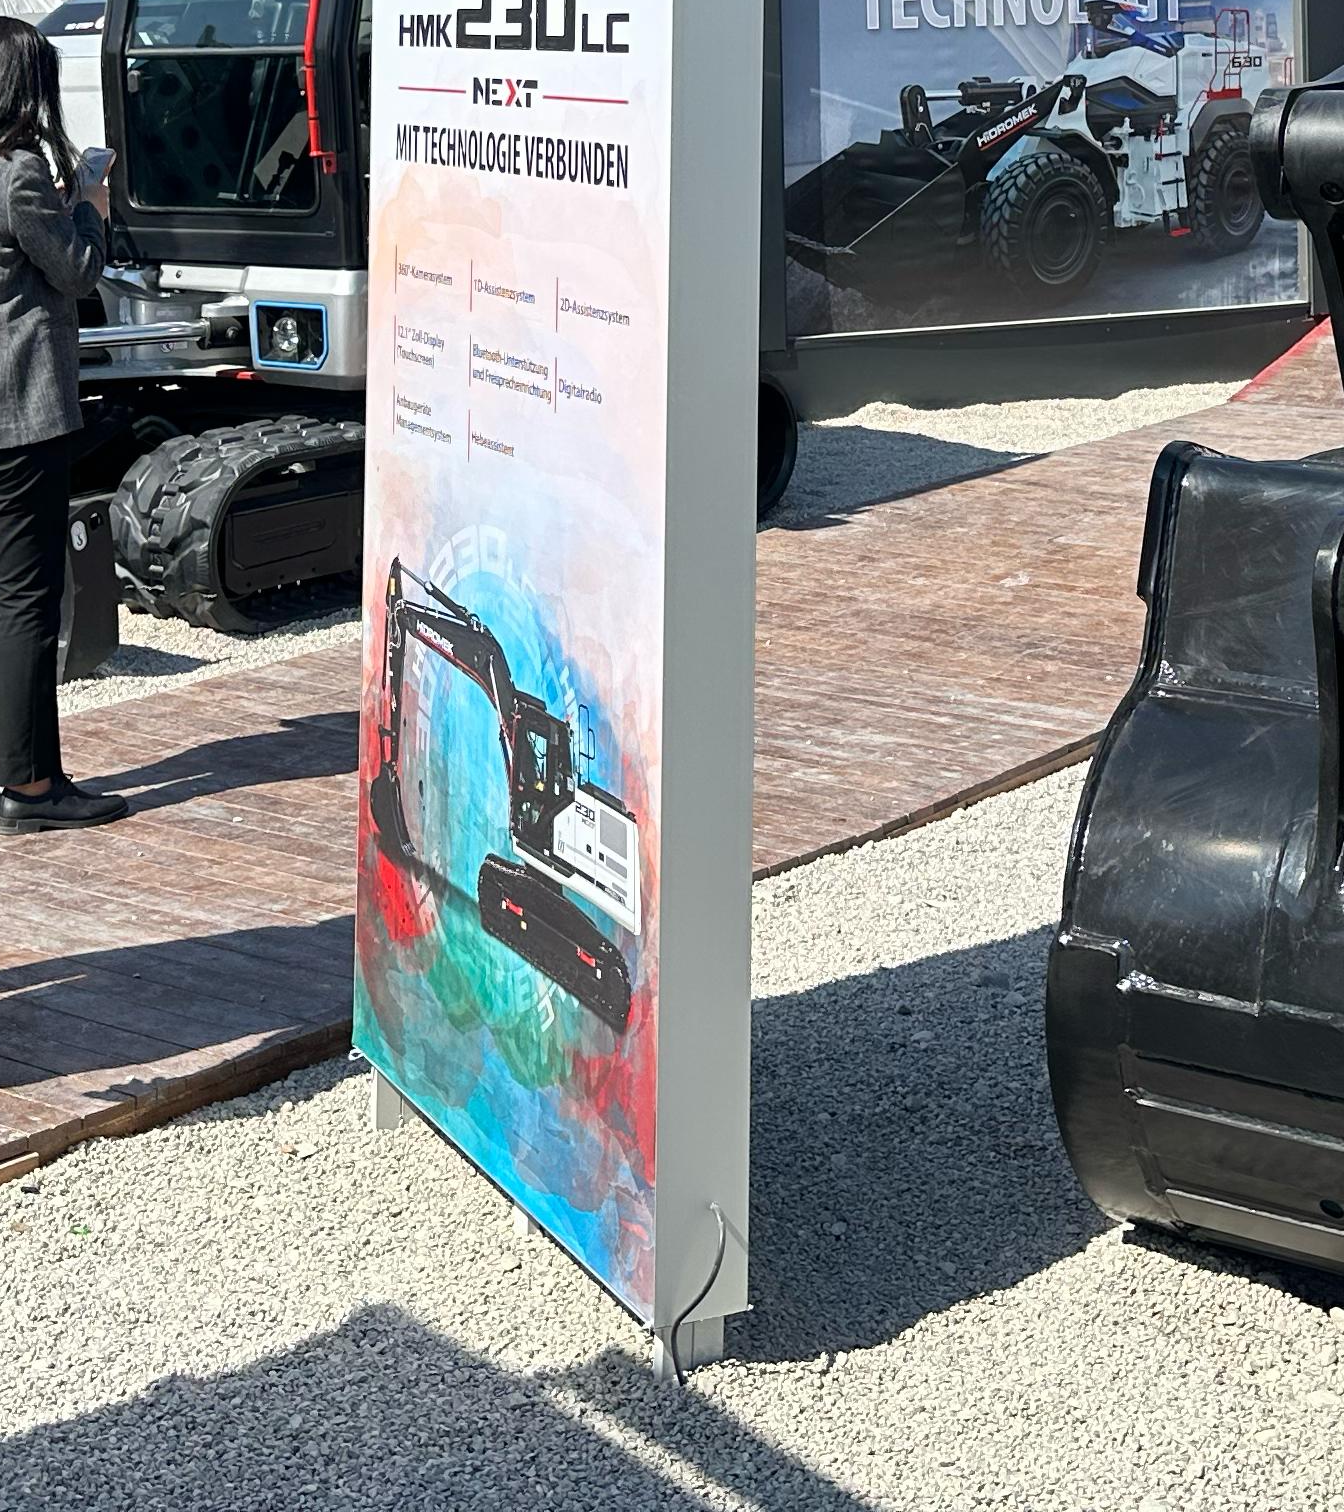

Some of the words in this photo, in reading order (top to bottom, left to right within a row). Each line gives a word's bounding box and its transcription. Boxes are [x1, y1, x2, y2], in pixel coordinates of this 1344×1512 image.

[581, 13, 630, 53] LC
[473, 77, 538, 108] NEXT
[396, 124, 420, 163] MIT
[423, 126, 521, 175] TECHNOLOGIE
[524, 136, 629, 189] VERBUNDEN
[560, 298, 630, 326] 2D-Assistenzsystem
[559, 379, 602, 404] Digitalradio
